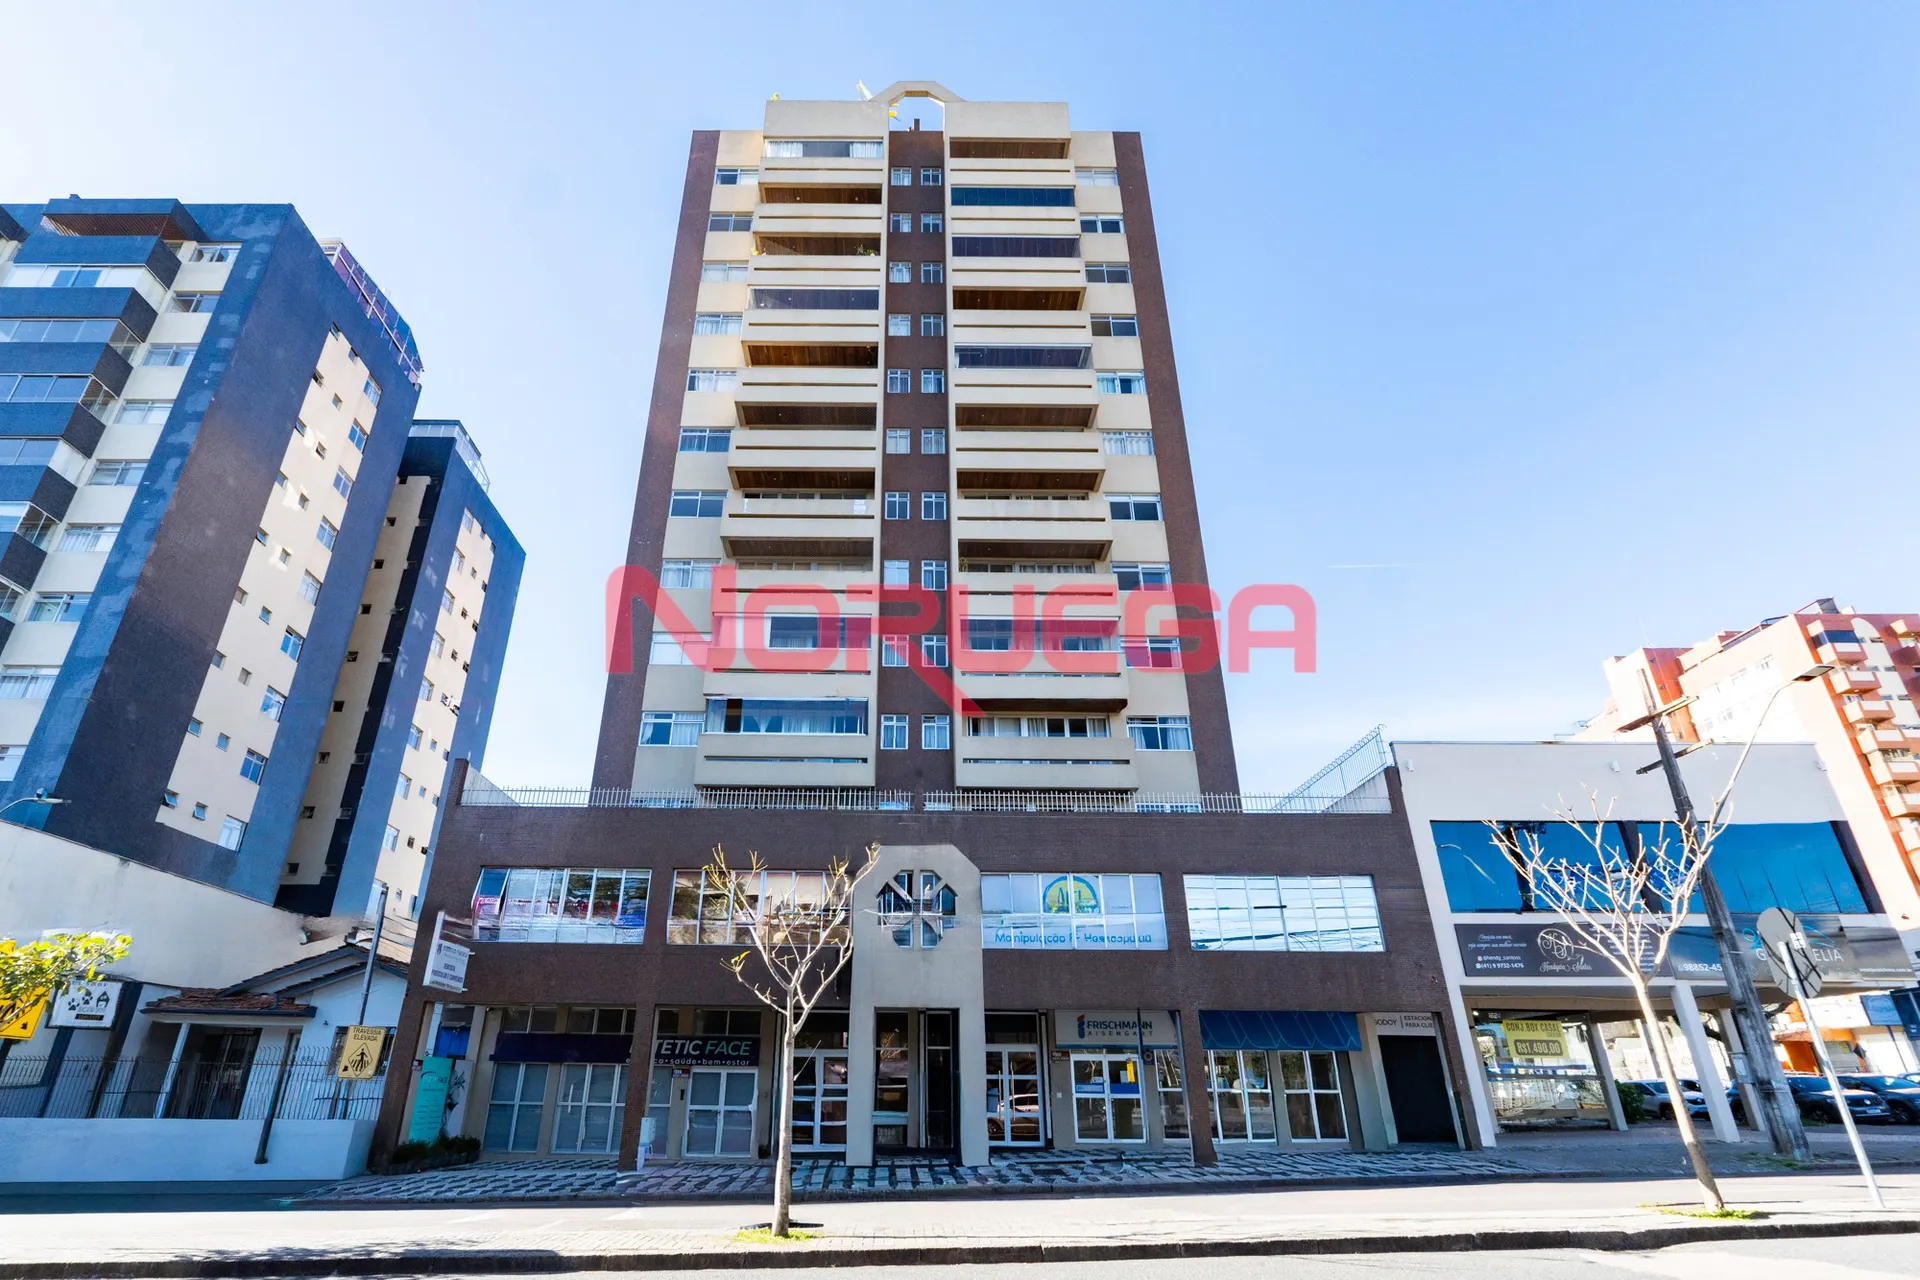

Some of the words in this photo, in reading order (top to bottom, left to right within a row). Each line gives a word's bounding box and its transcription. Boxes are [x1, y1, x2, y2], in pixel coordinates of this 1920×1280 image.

[1086, 1020, 1153, 1030] FRISCHMANN
[353, 1027, 382, 1035] TRAVESSIA
[353, 1034, 378, 1042] ELEVADA
[705, 1041, 753, 1056] FACE
[702, 1058, 721, 1066] bem
